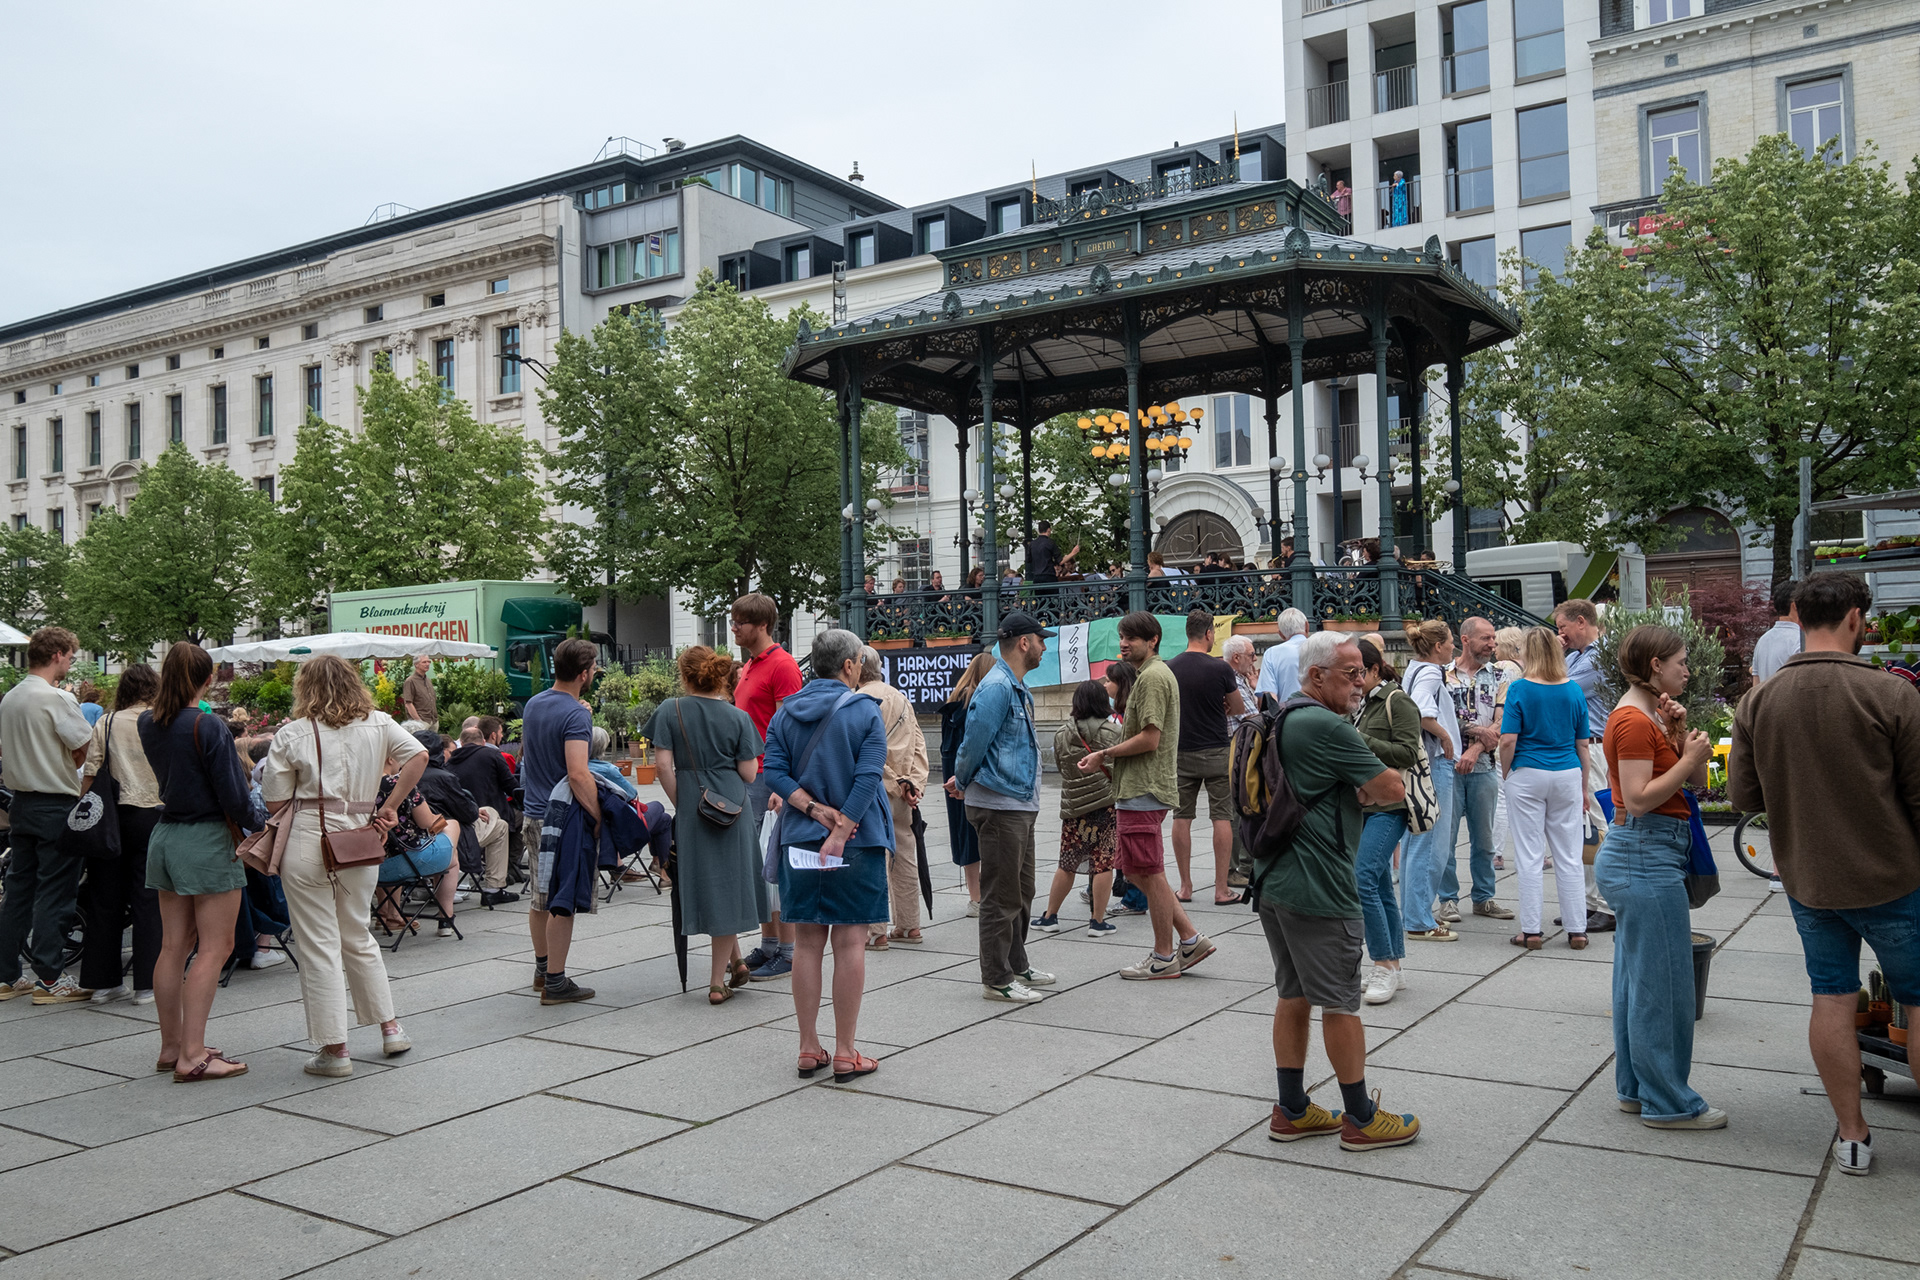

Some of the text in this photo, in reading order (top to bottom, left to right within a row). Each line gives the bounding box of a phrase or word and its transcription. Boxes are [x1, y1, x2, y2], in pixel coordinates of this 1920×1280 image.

[359, 601, 447, 618] Bloemenkwekerij
[897, 653, 973, 672] HARMONIE
[897, 671, 952, 688] ORKEST
[921, 686, 956, 703] PINT
